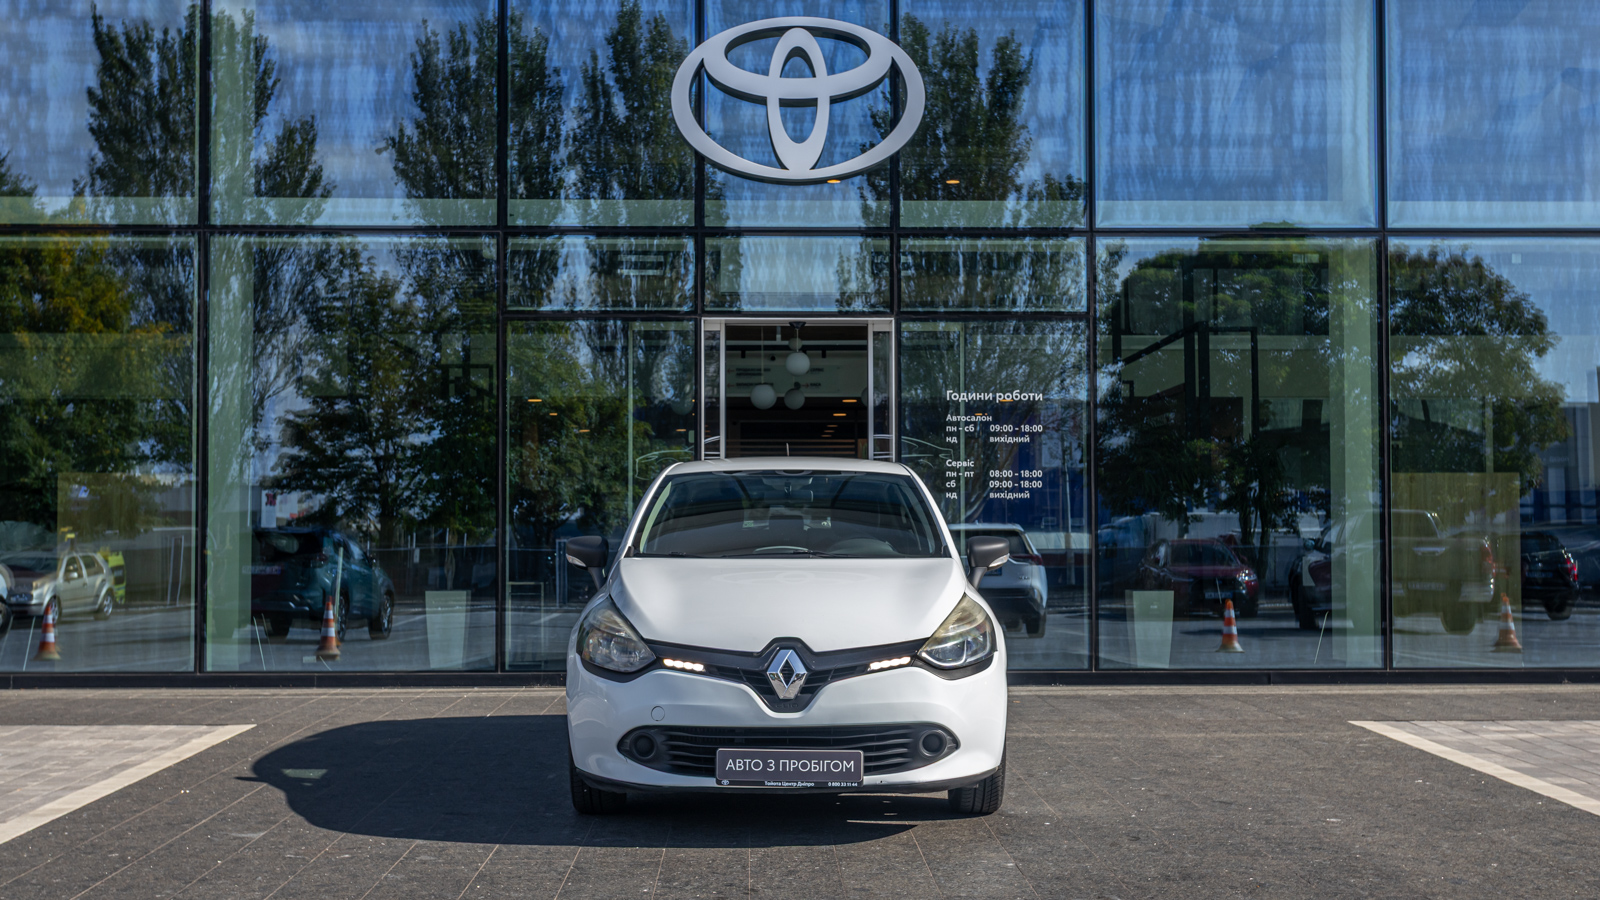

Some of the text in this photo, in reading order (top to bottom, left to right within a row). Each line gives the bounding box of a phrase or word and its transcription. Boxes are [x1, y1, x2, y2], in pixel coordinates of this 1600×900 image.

[946, 390, 1043, 403] Години роботи
[964, 424, 974, 432] сб
[990, 435, 1030, 444] вихідний
[946, 459, 974, 468] Сервіс
[946, 480, 956, 488] сб
[990, 491, 1030, 499] вихідний
[726, 759, 762, 771] АВТО
[780, 760, 854, 772] ПРОБІГОМ
